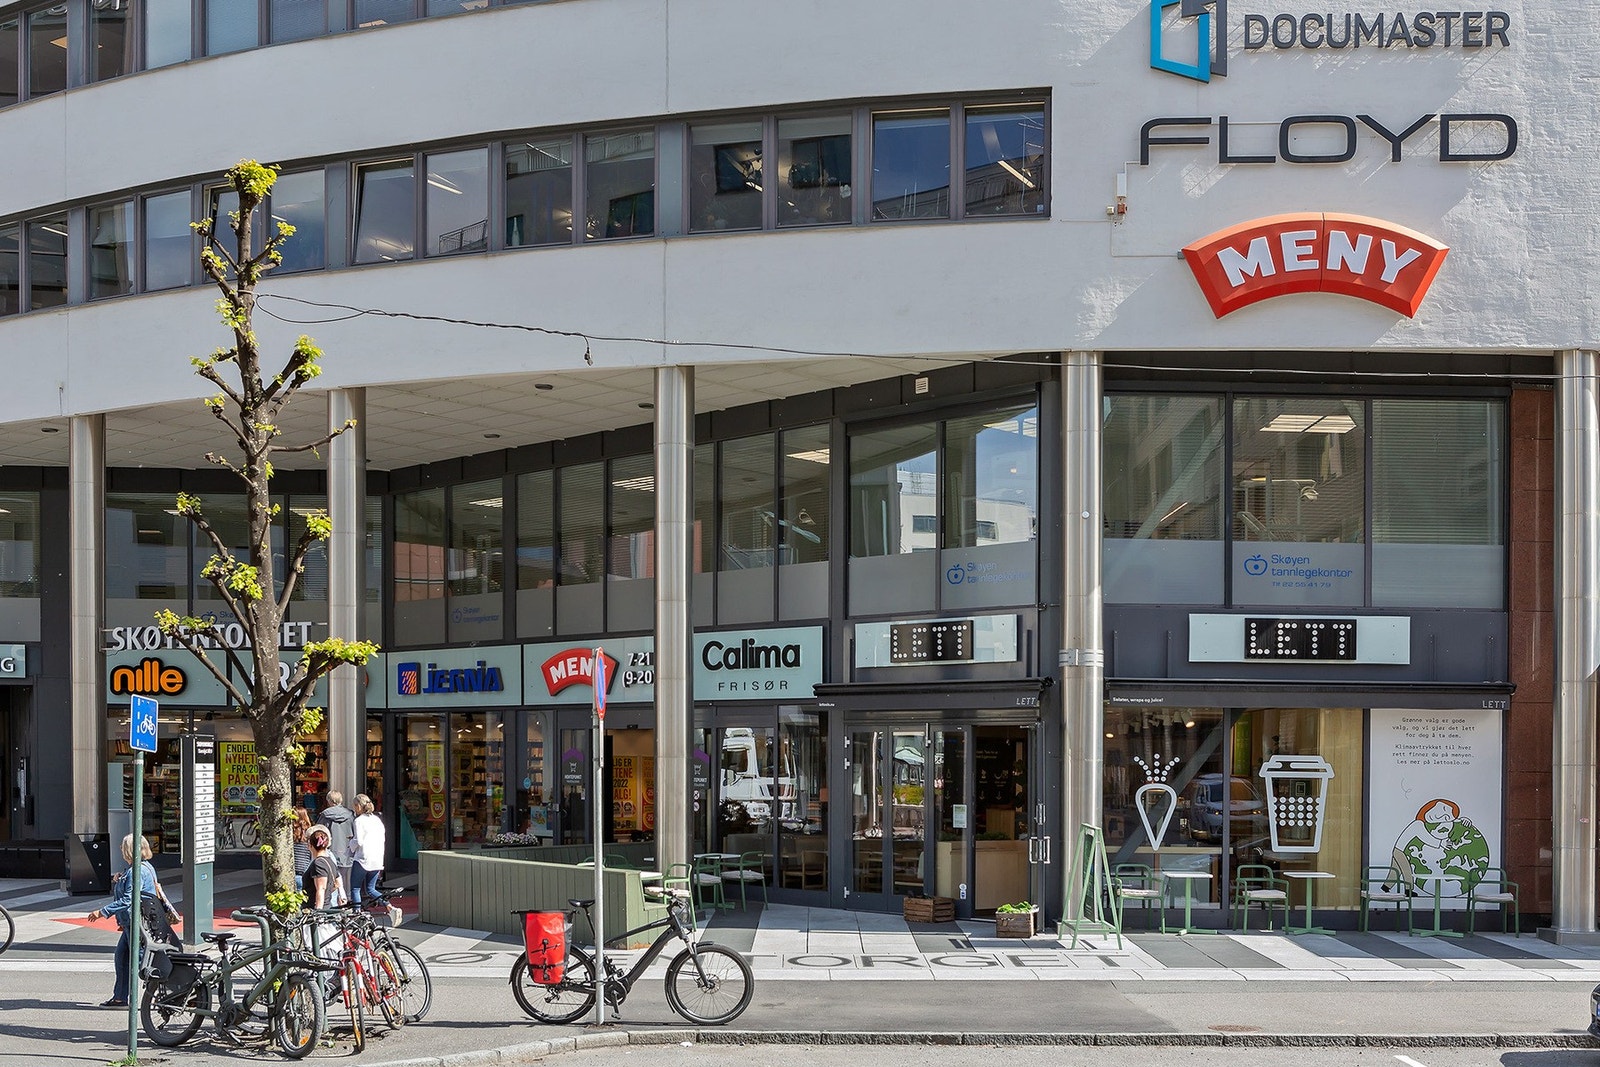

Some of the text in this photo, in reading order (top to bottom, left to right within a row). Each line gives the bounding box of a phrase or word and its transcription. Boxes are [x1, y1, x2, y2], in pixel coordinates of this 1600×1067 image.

[1244, 12, 1511, 49] DOCUMASTER
[1140, 114, 1518, 165] FLOYD
[1217, 230, 1422, 287] MENY
[1271, 554, 1310, 566] Skøyen
[1271, 568, 1352, 579] tannlegekontor
[112, 622, 311, 650] SKØYENTOET
[893, 625, 967, 658] LETT
[1250, 622, 1352, 656] LETT
[627, 652, 650, 666] 7-21
[702, 638, 801, 671] Calima
[113, 660, 184, 693] nille
[550, 656, 607, 684] MEN
[718, 680, 788, 691] FRISØR
[1016, 697, 1036, 706] LETT
[1482, 700, 1506, 708] LETT
[226, 744, 256, 753] ENDELI
[226, 753, 258, 764] NYHET
[232, 765, 259, 774] FRA 20
[613, 768, 633, 779] TENE
[613, 788, 632, 800] ALG!
